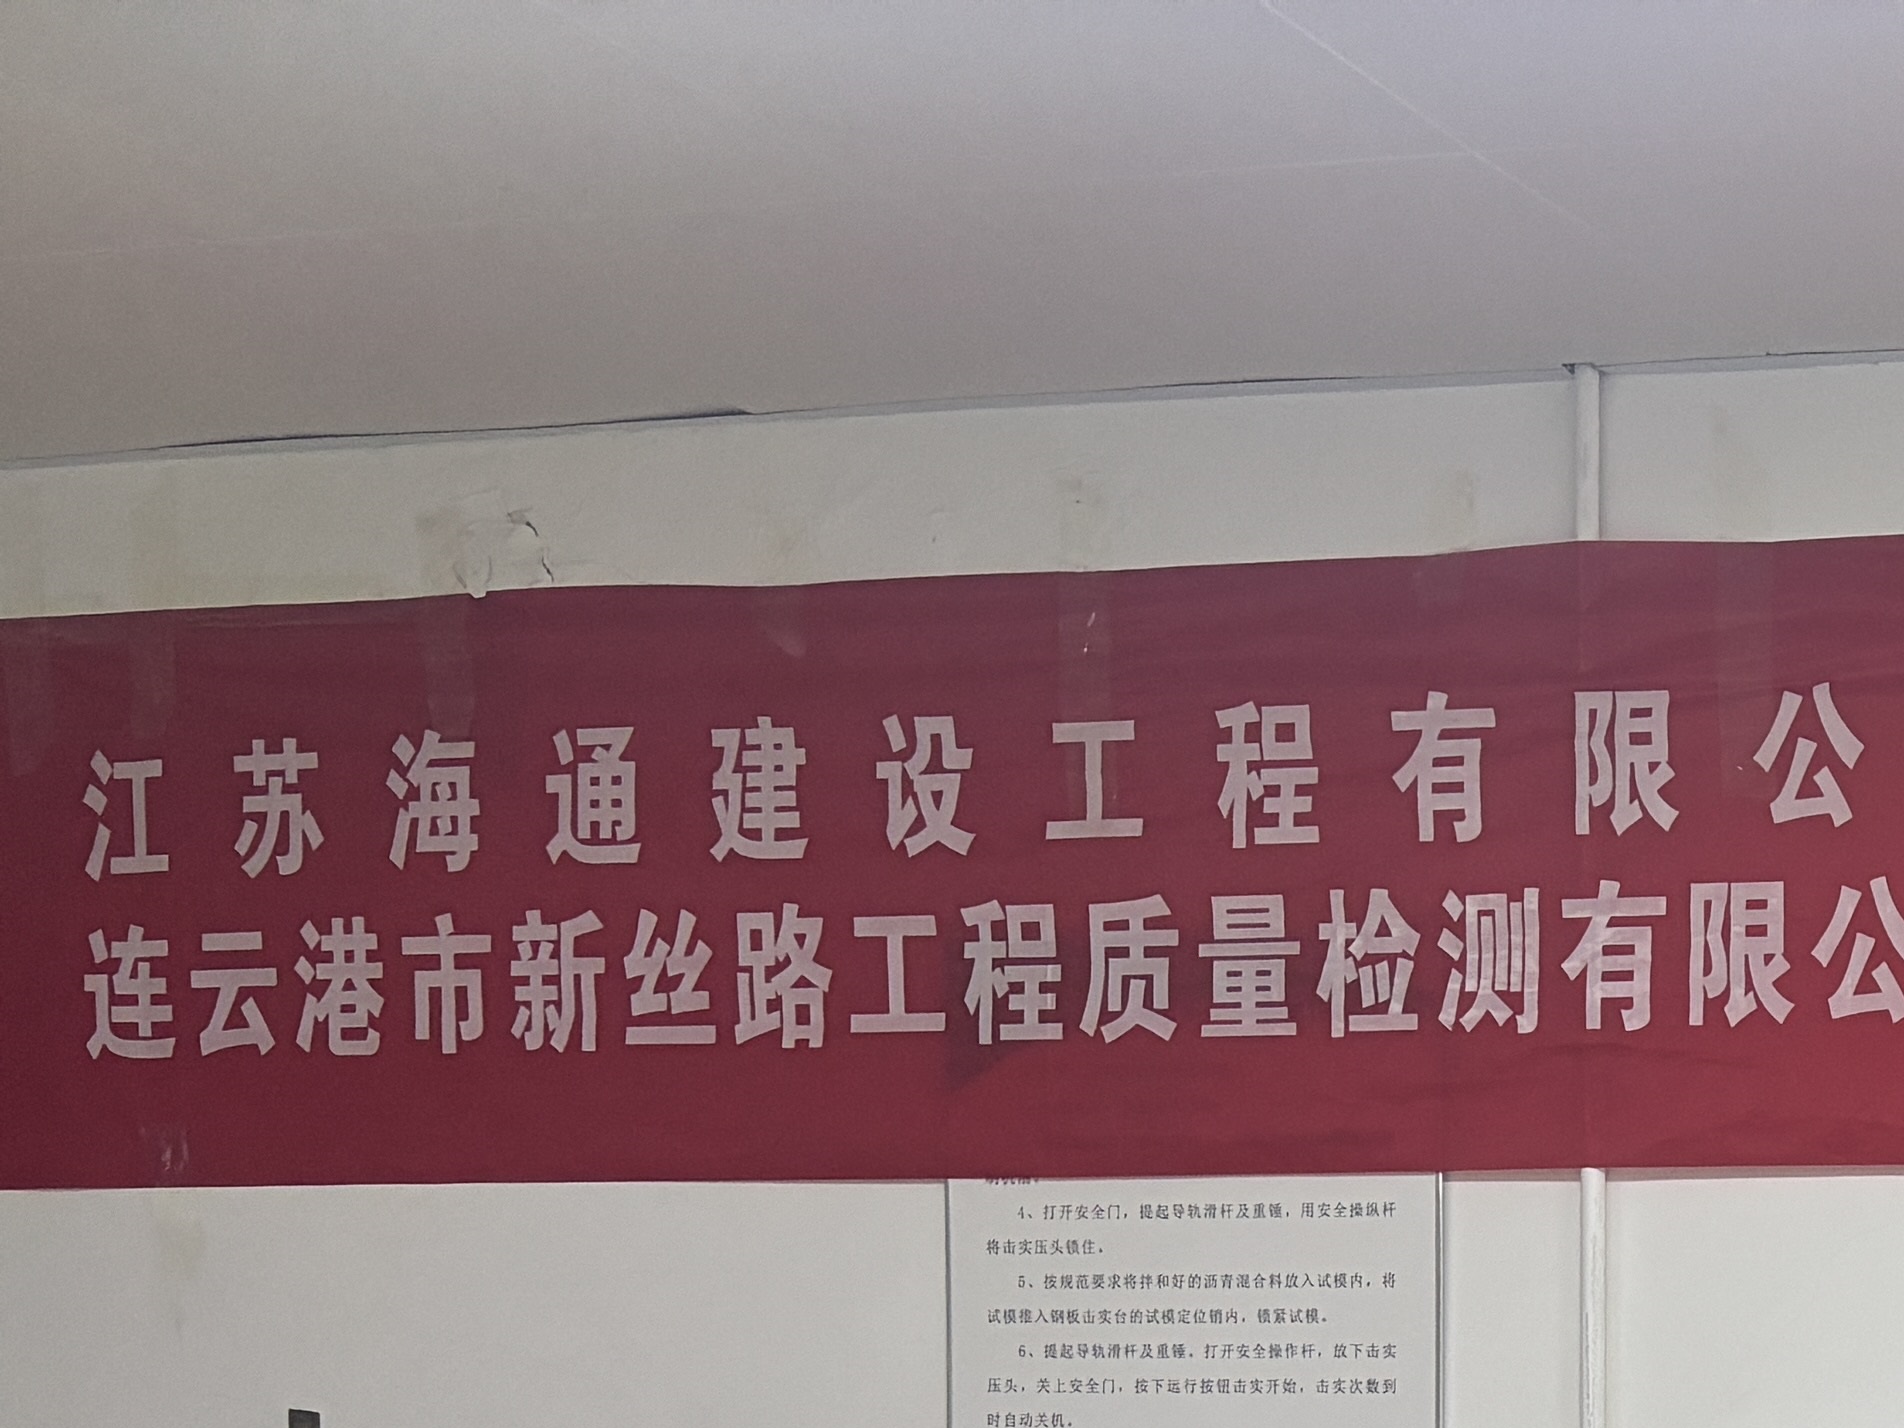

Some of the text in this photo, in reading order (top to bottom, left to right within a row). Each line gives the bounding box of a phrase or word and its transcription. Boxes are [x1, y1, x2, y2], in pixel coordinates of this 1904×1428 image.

[987, 1411, 1073, 1428] 时自动关机。
